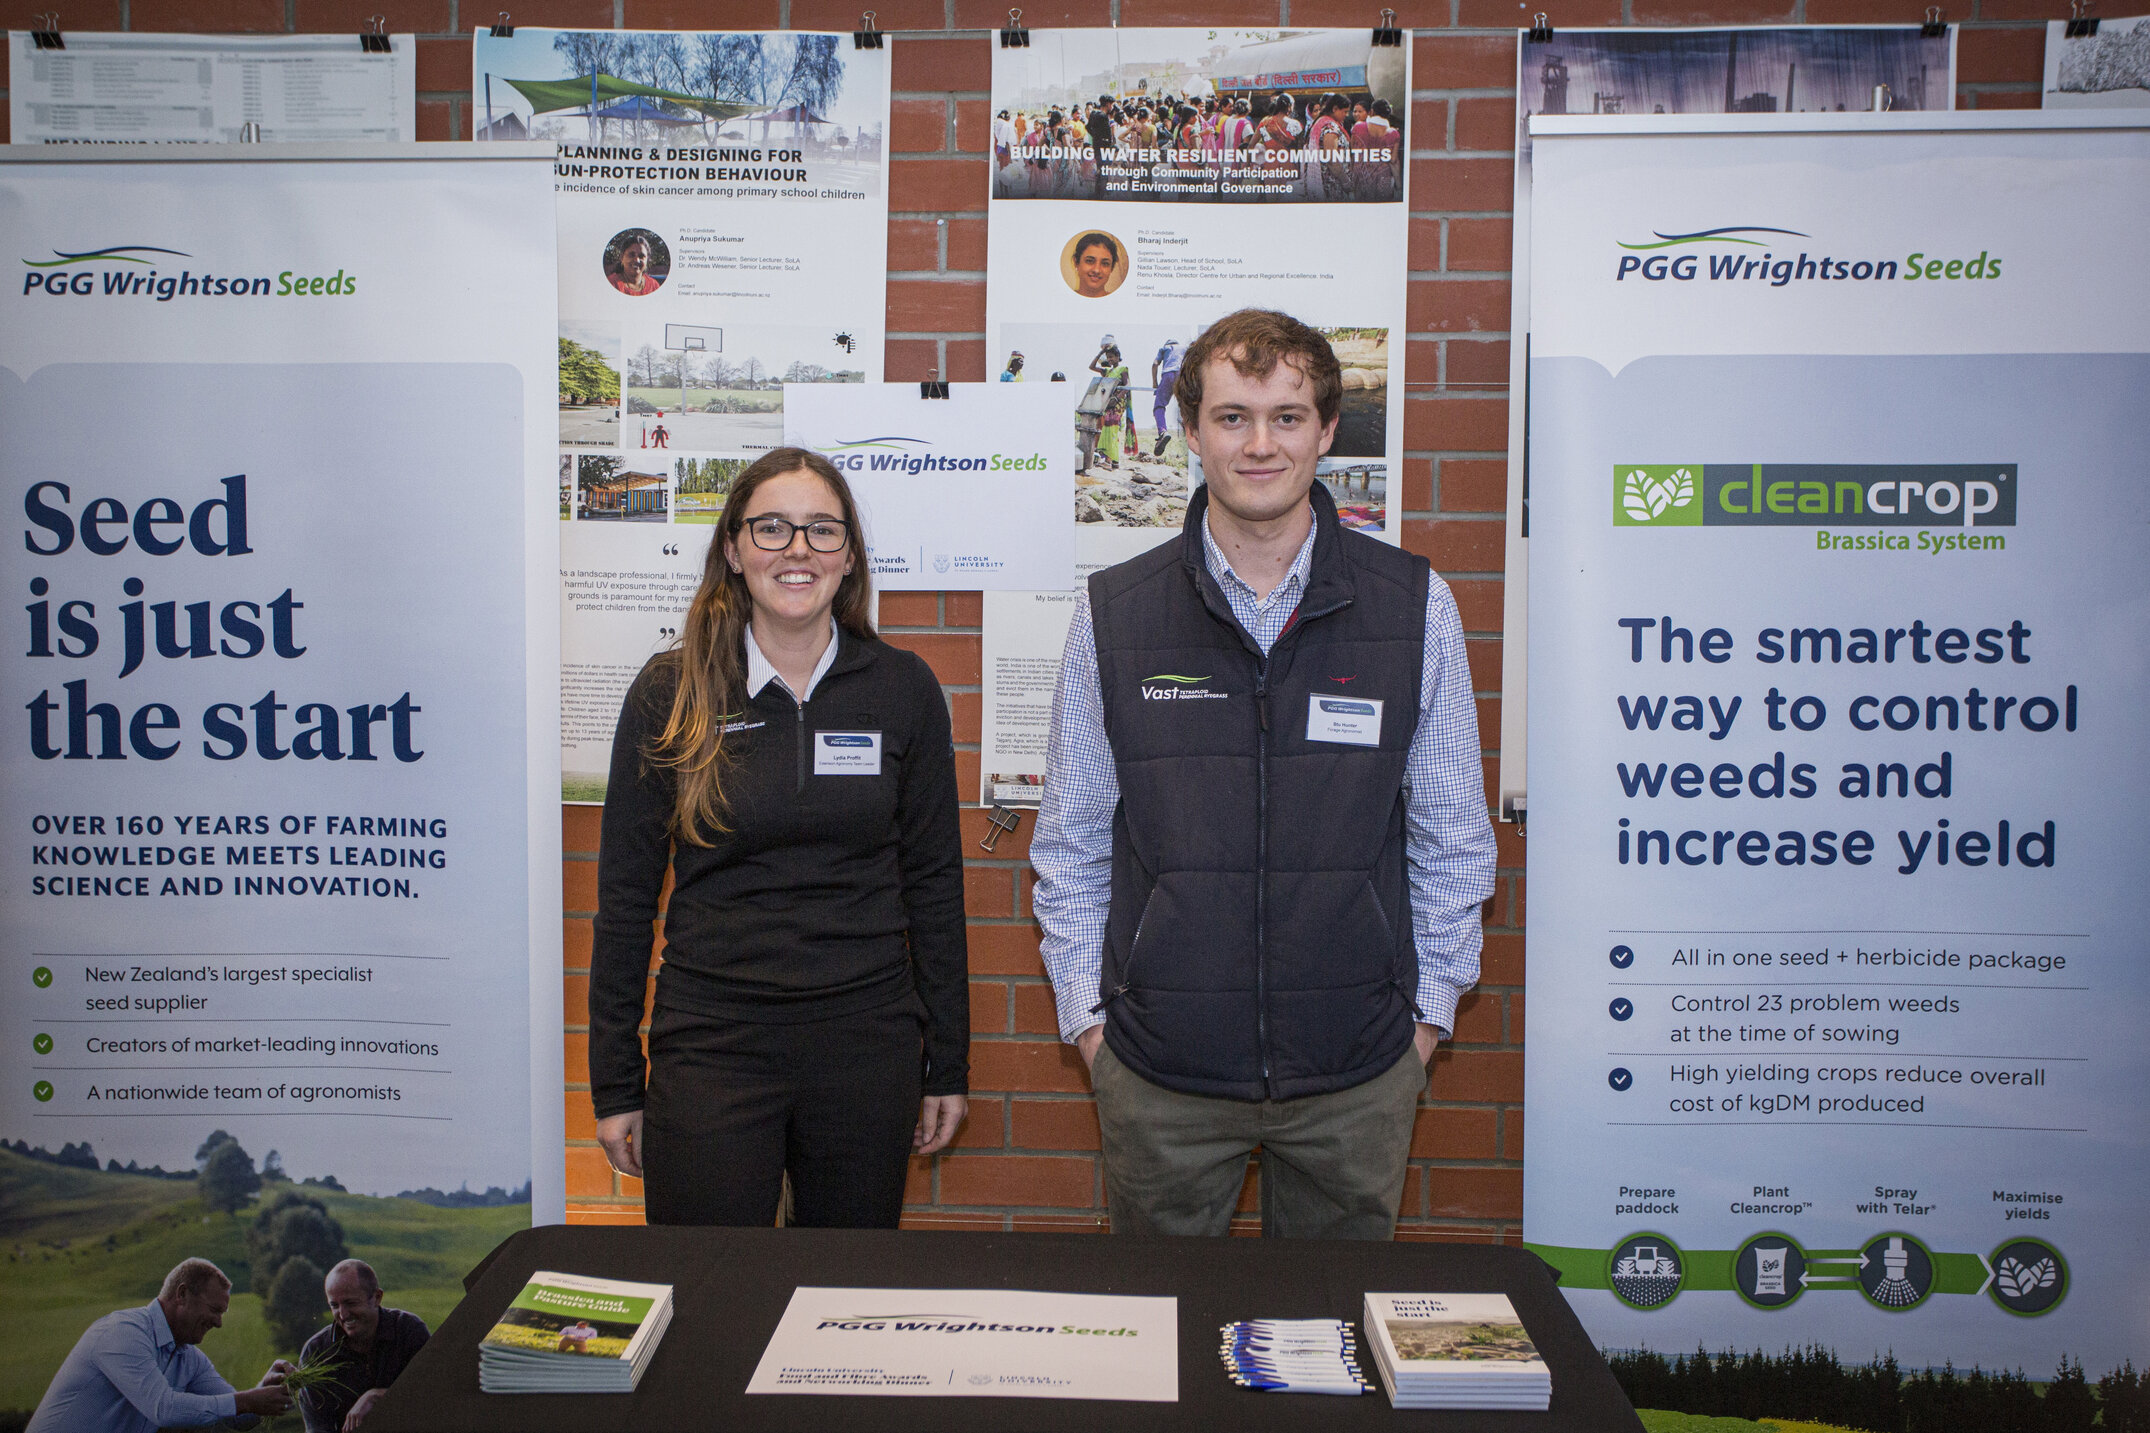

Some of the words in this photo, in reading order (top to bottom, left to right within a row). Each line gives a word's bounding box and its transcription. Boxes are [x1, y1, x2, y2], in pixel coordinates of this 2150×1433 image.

[649, 149, 660, 160] &
[667, 149, 761, 162] DESIGNING
[769, 150, 802, 162] FOR
[1010, 146, 1094, 160] BUILDING
[1100, 148, 1161, 162] WATER
[1167, 149, 1259, 162] RESILIENT
[1264, 149, 1392, 162] COMMUNITIES
[706, 168, 807, 181] BEHAVIOUR
[1102, 166, 1148, 178] through
[1152, 167, 1219, 179] Community
[1224, 168, 1298, 180] Participation
[564, 183, 615, 193] incidence
[619, 185, 629, 194] of
[633, 186, 654, 194] skin
[697, 188, 733, 197] among
[737, 187, 777, 198] primary
[781, 189, 817, 198] school
[821, 189, 865, 200] children
[1106, 181, 1128, 191] and
[1132, 182, 1217, 192] Environmental
[1220, 183, 1293, 193] Governance
[680, 236, 710, 244] Anupriya
[1138, 237, 1161, 245] Bharaj
[1616, 256, 1696, 280] PGG
[1708, 253, 1897, 286] Wrightson
[1904, 252, 2001, 280] Seeds
[23, 273, 93, 296] PGG
[104, 270, 271, 301] Wrightson
[277, 269, 357, 296] Seeds
[829, 454, 864, 471] GG
[870, 454, 986, 475] Wrightson
[990, 453, 1047, 471] Seeds
[25, 475, 253, 556] Seed
[1817, 531, 1910, 550] Brassica
[1918, 531, 2006, 555] System
[578, 570, 617, 578] landscape
[676, 572, 696, 582] firmly
[568, 592, 599, 600] grounds
[649, 584, 678, 592] through
[26, 577, 99, 658] is
[119, 577, 307, 678] just
[1618, 616, 1734, 664] The
[1757, 620, 2032, 664] smartest
[1142, 686, 1179, 700] Vast
[26, 680, 180, 760] the
[203, 690, 425, 763] start
[1618, 695, 1742, 740] way
[1764, 688, 1826, 732] to
[1849, 684, 2078, 732] control
[1616, 752, 1817, 798] weeds
[1839, 752, 1952, 798] and
[32, 815, 105, 835] OVER
[117, 815, 163, 835] 160
[174, 815, 270, 835] YEARS
[280, 815, 316, 836] OF
[327, 817, 447, 839] FARMING
[1618, 818, 1875, 866] increase
[1898, 819, 2056, 875] yield
[33, 846, 215, 866] KNOWLEDGE
[226, 846, 320, 866] MEETS
[329, 846, 447, 868] LEADING
[32, 876, 150, 896] SCIENCE
[160, 876, 223, 896] AND
[234, 876, 419, 898] INNOVATION.
[1672, 948, 1701, 966] All
[1708, 948, 1725, 966] in
[1733, 952, 1772, 967] one
[1780, 949, 1828, 966] seed
[1838, 952, 1848, 964] +
[1856, 948, 1960, 968] herbicide
[1969, 951, 2066, 973] package
[86, 967, 126, 982] New
[224, 966, 286, 986] largest
[292, 966, 373, 987] specialist
[86, 994, 130, 1011] seed
[134, 994, 208, 1016] supplier
[1672, 994, 1750, 1012] Control
[1758, 996, 1782, 1012] 23
[1790, 994, 1880, 1017] problem
[1888, 996, 1960, 1013] weeds
[1670, 1026, 1692, 1042] at
[1698, 1024, 1732, 1042] the
[1740, 1024, 1787, 1042] time
[1794, 1024, 1815, 1042] of
[1822, 1026, 1900, 1047] sowing
[86, 1037, 166, 1054] Creators
[172, 1037, 190, 1053] of
[195, 1036, 336, 1056] market-leading
[340, 1038, 439, 1056] innovations
[1670, 1064, 1719, 1088] High
[1726, 1065, 1810, 1088] yielding
[1817, 1068, 1878, 1087] crops
[1886, 1067, 1962, 1084] reduce
[1970, 1068, 2046, 1086] overall
[87, 1086, 100, 1100] A
[105, 1083, 208, 1100] nationwide
[214, 1085, 261, 1100] team
[267, 1083, 286, 1100] of
[290, 1084, 402, 1104] agronomists
[1670, 1097, 1714, 1112] cost
[1721, 1094, 1743, 1112] of
[1750, 1094, 1810, 1117] kgDM
[1818, 1094, 1924, 1117] produced
[1619, 1186, 1676, 1202] Prepare
[1752, 1185, 1789, 1198] Plant
[1875, 1186, 1918, 1204] Spray
[1992, 1190, 2062, 1205] Maximise
[1616, 1201, 1679, 1218] paddock
[1856, 1201, 1888, 1215] with
[2006, 1206, 2050, 1222] yields
[596, 1299, 624, 1307] and
[816, 1321, 886, 1330] PGG
[895, 1322, 1054, 1333] Wrightson
[1059, 1326, 1138, 1336] Seeds
